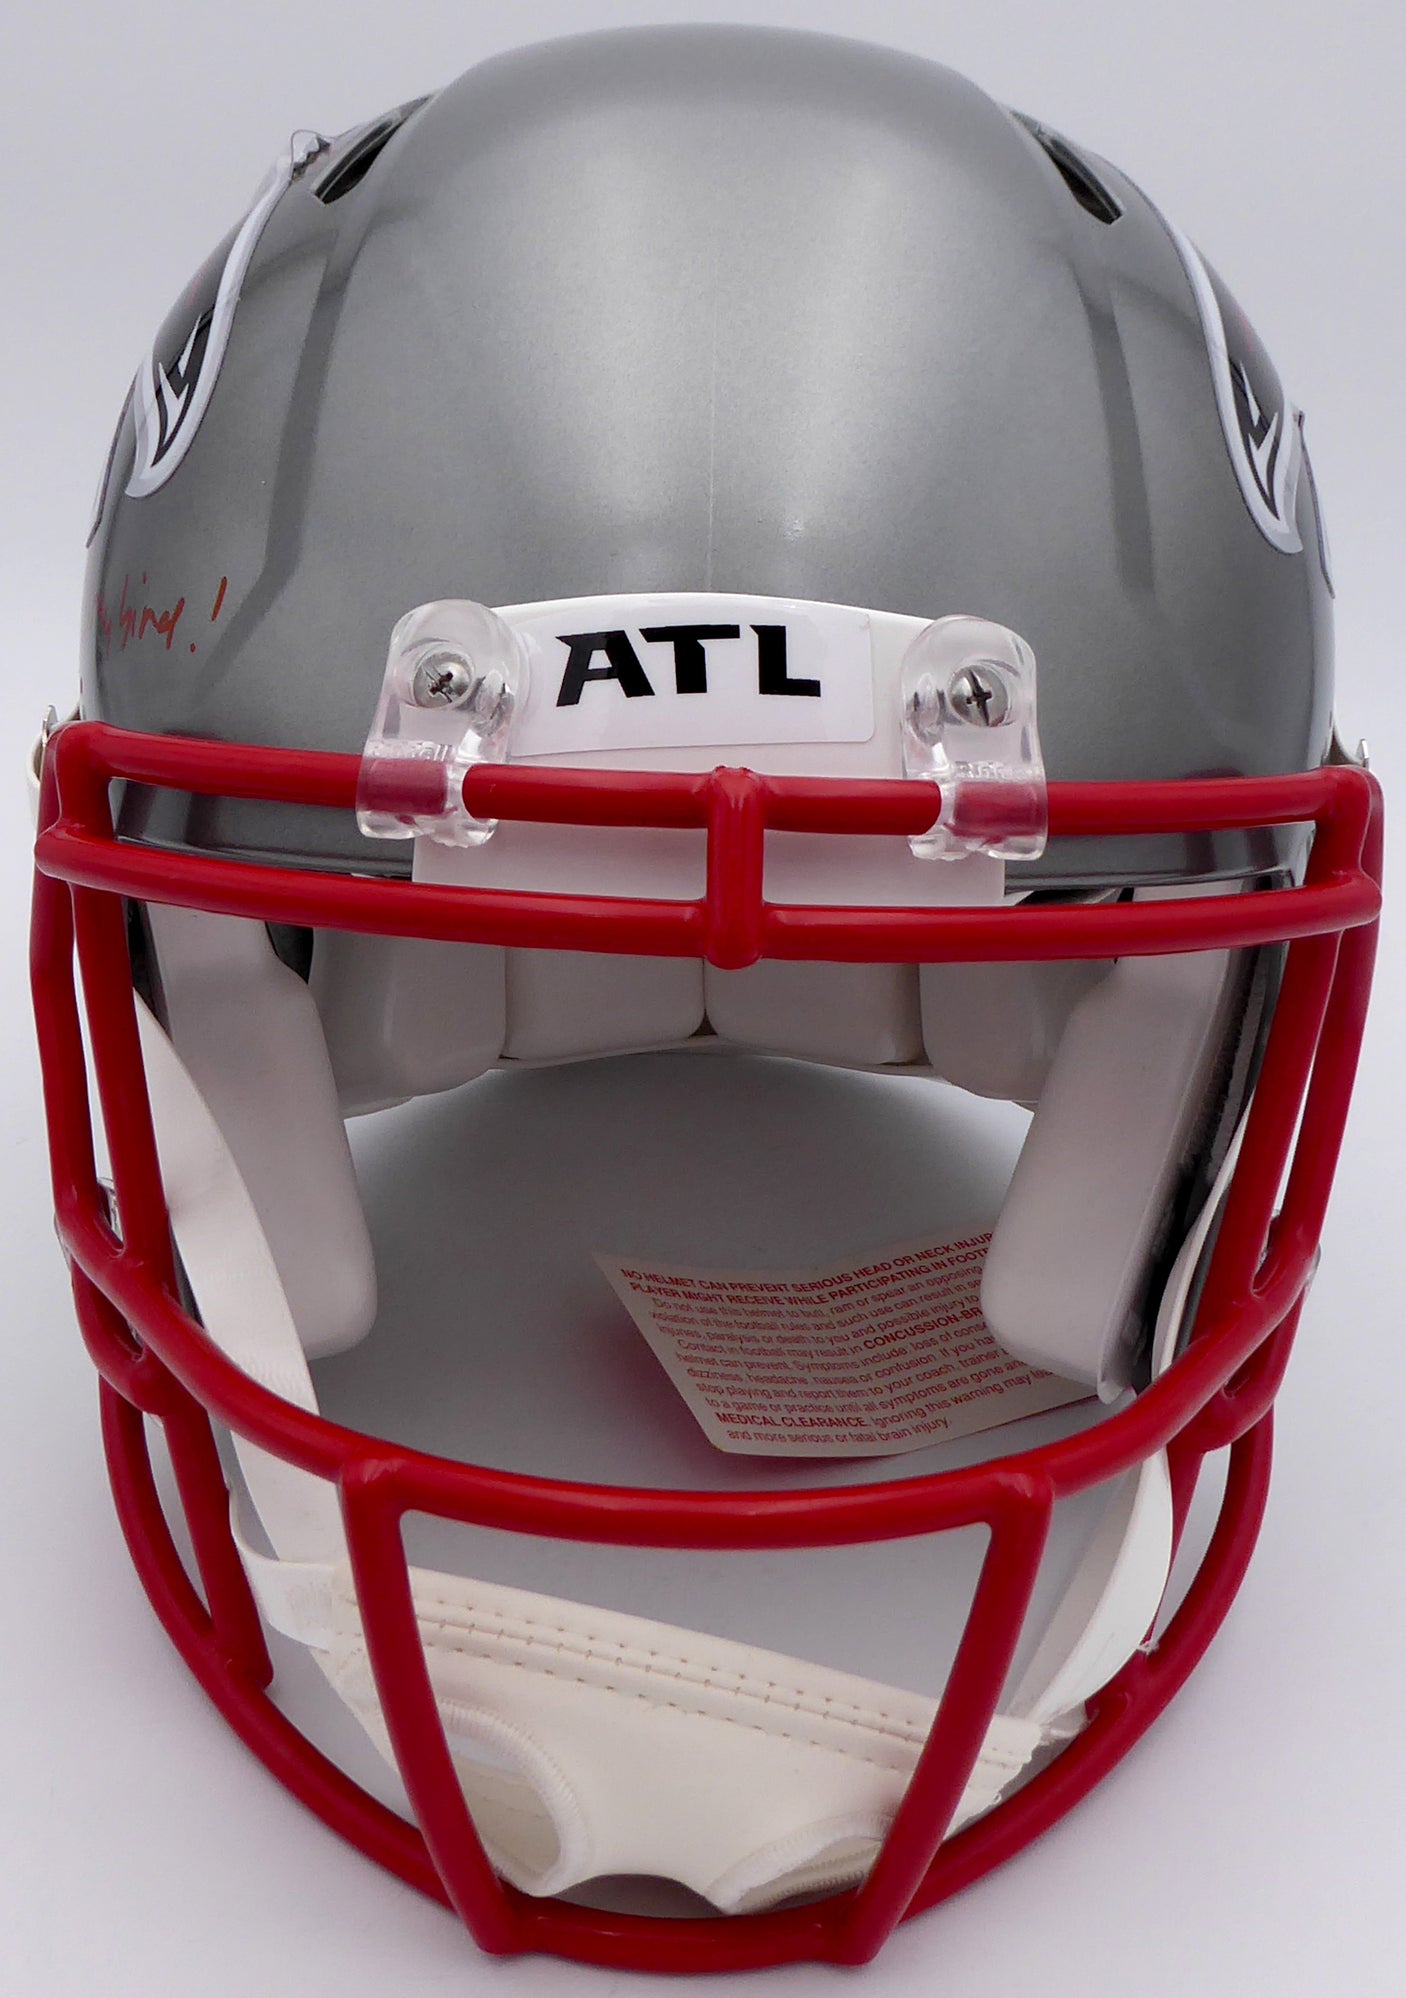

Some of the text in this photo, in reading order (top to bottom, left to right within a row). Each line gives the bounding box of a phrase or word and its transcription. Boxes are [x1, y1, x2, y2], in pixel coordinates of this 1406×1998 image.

[555, 623, 821, 708] ATL
[620, 1268, 642, 1281] NO
[643, 1272, 697, 1288] HELMET
[699, 1280, 729, 1291] CAN
[728, 1282, 789, 1293] PREVENT
[791, 1273, 853, 1293] SERIOUS
[852, 1262, 892, 1279] HEAD
[893, 1255, 915, 1267] OR
[915, 1244, 955, 1261] NECK
[629, 1282, 682, 1298] PLAYER
[682, 1290, 724, 1302] MIGHT
[726, 1294, 785, 1305] RECEIVE
[784, 1295, 829, 1305] WHILE
[828, 1264, 932, 1300] PARTICIPATING
[931, 1260, 948, 1270] IN
[652, 1298, 671, 1309] Do
[673, 1302, 693, 1312] not
[786, 1309, 799, 1318] to
[830, 1302, 855, 1315] ram
[856, 1297, 869, 1307] or
[871, 1286, 905, 1302] spear
[907, 1281, 924, 1292] an
[926, 1265, 983, 1286] opposing
[761, 1335, 773, 1343] or
[776, 1334, 809, 1344] death
[811, 1335, 826, 1344] to
[827, 1333, 850, 1345] you
[852, 1323, 876, 1338] and
[877, 1308, 930, 1333] possible
[930, 1298, 966, 1314] injury
[965, 1294, 980, 1304] to
[781, 1321, 811, 1331] rules
[814, 1320, 836, 1330] and
[836, 1312, 868, 1328] such
[870, 1305, 893, 1317] use
[894, 1297, 918, 1310] can
[919, 1285, 954, 1302] result
[954, 1282, 967, 1292] in
[675, 1352, 719, 1367] helmet
[720, 1359, 742, 1368] can
[792, 1360, 860, 1372] Symptoms
[910, 1336, 939, 1351] loss
[939, 1330, 953, 1342] of
[677, 1339, 726, 1354] Contact
[727, 1346, 740, 1354] in
[740, 1345, 785, 1356] football
[786, 1349, 814, 1360] may
[815, 1347, 848, 1357] result
[849, 1344, 863, 1354] in
[696, 1382, 725, 1395] stop
[725, 1384, 773, 1400] playing
[772, 1388, 797, 1398] and
[799, 1389, 835, 1399] report
[835, 1388, 869, 1399] them
[868, 1385, 884, 1397] to
[884, 1376, 913, 1394] your
[959, 1348, 1001, 1368] trainer
[813, 1376, 858, 1385] nausea
[859, 1373, 873, 1383] or
[951, 1342, 976, 1357] you
[705, 1397, 720, 1408] to
[722, 1401, 731, 1409] a
[732, 1401, 768, 1412] game
[769, 1403, 782, 1412] or
[784, 1403, 835, 1414] practice
[835, 1401, 862, 1413] until
[862, 1400, 878, 1412] all
[878, 1382, 948, 1410] symptoms
[947, 1375, 970, 1389] are
[969, 1365, 1004, 1384] gone
[714, 1411, 781, 1427] MEDICAL
[871, 1407, 927, 1429] Ignoring
[925, 1398, 952, 1412] this
[951, 1382, 1005, 1405] warning
[1004, 1373, 1032, 1386] may
[727, 1430, 752, 1441] and
[753, 1432, 786, 1442] more
[787, 1433, 834, 1444] serious
[835, 1434, 848, 1443] or
[848, 1431, 876, 1443] fatal
[877, 1426, 913, 1441] brain
